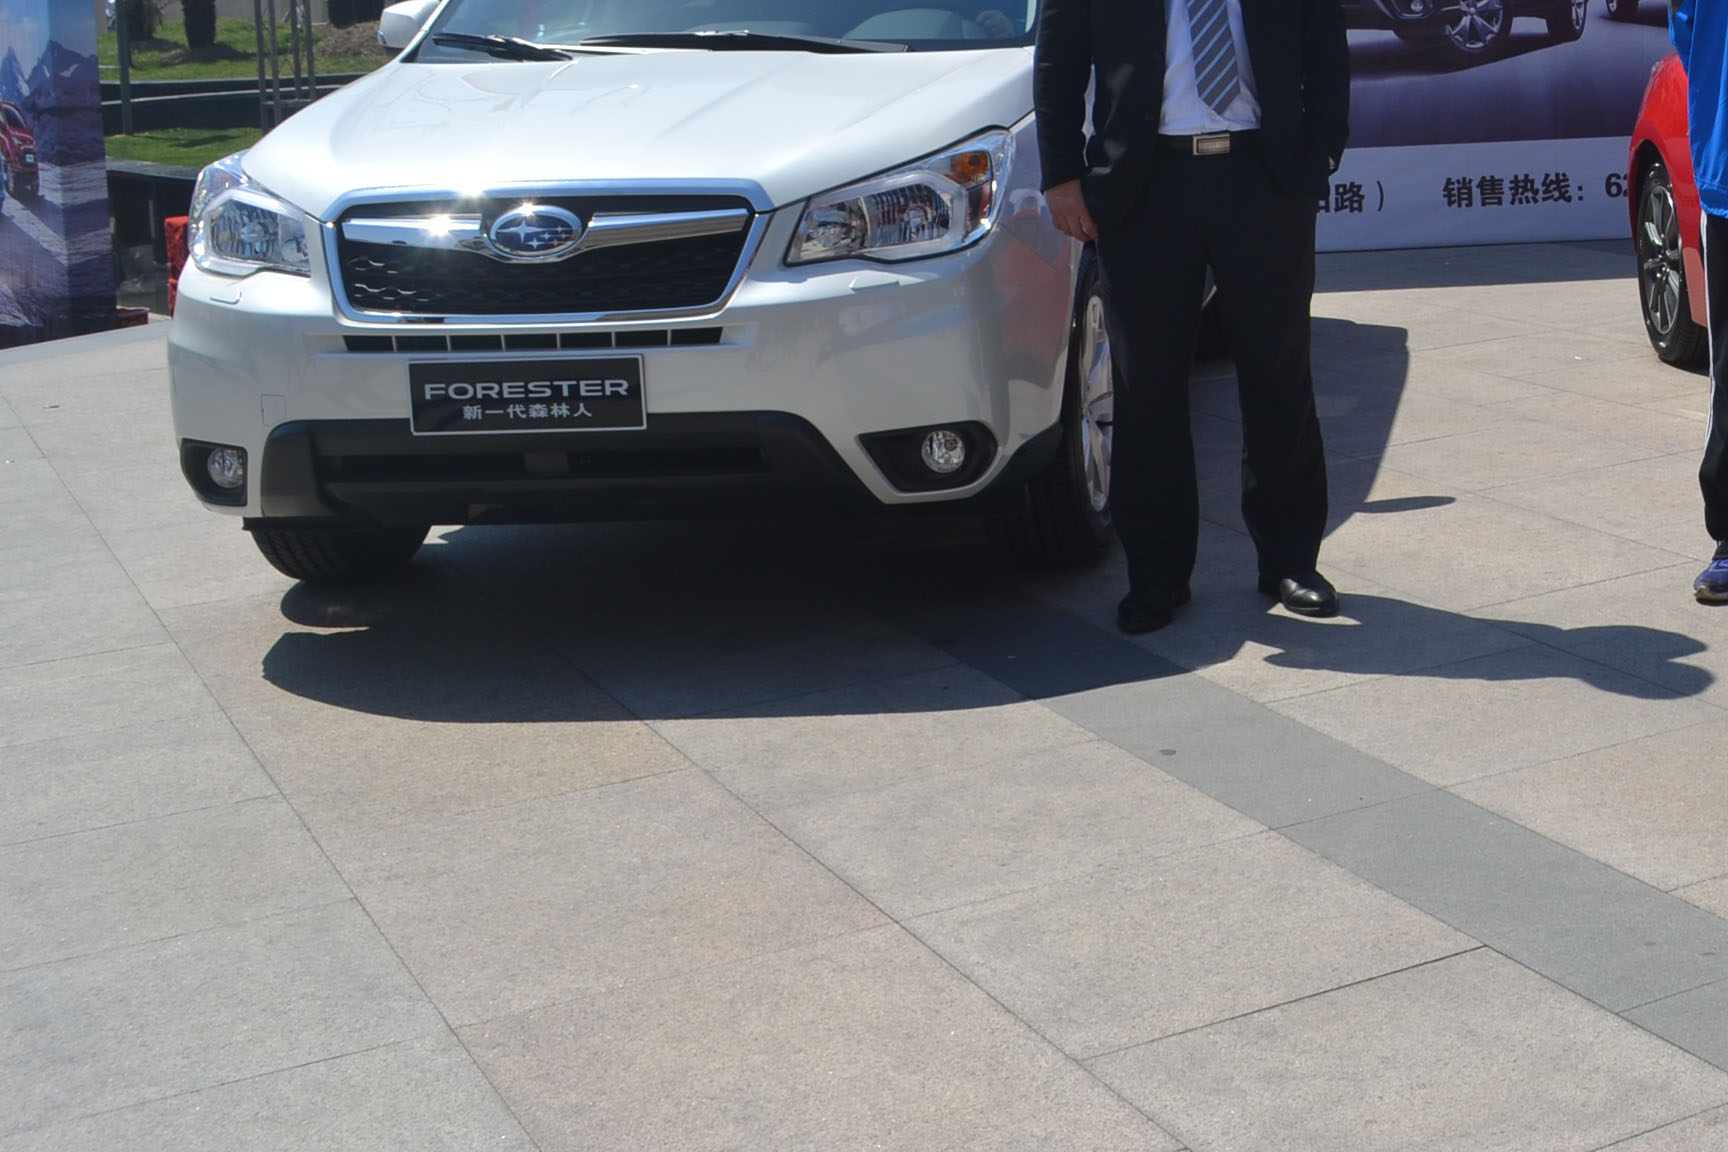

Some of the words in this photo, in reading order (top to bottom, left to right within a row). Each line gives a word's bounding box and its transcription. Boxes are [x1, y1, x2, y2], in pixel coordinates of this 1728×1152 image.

[424, 379, 629, 400] FORESTER
[463, 402, 592, 420] 新一代森林人
